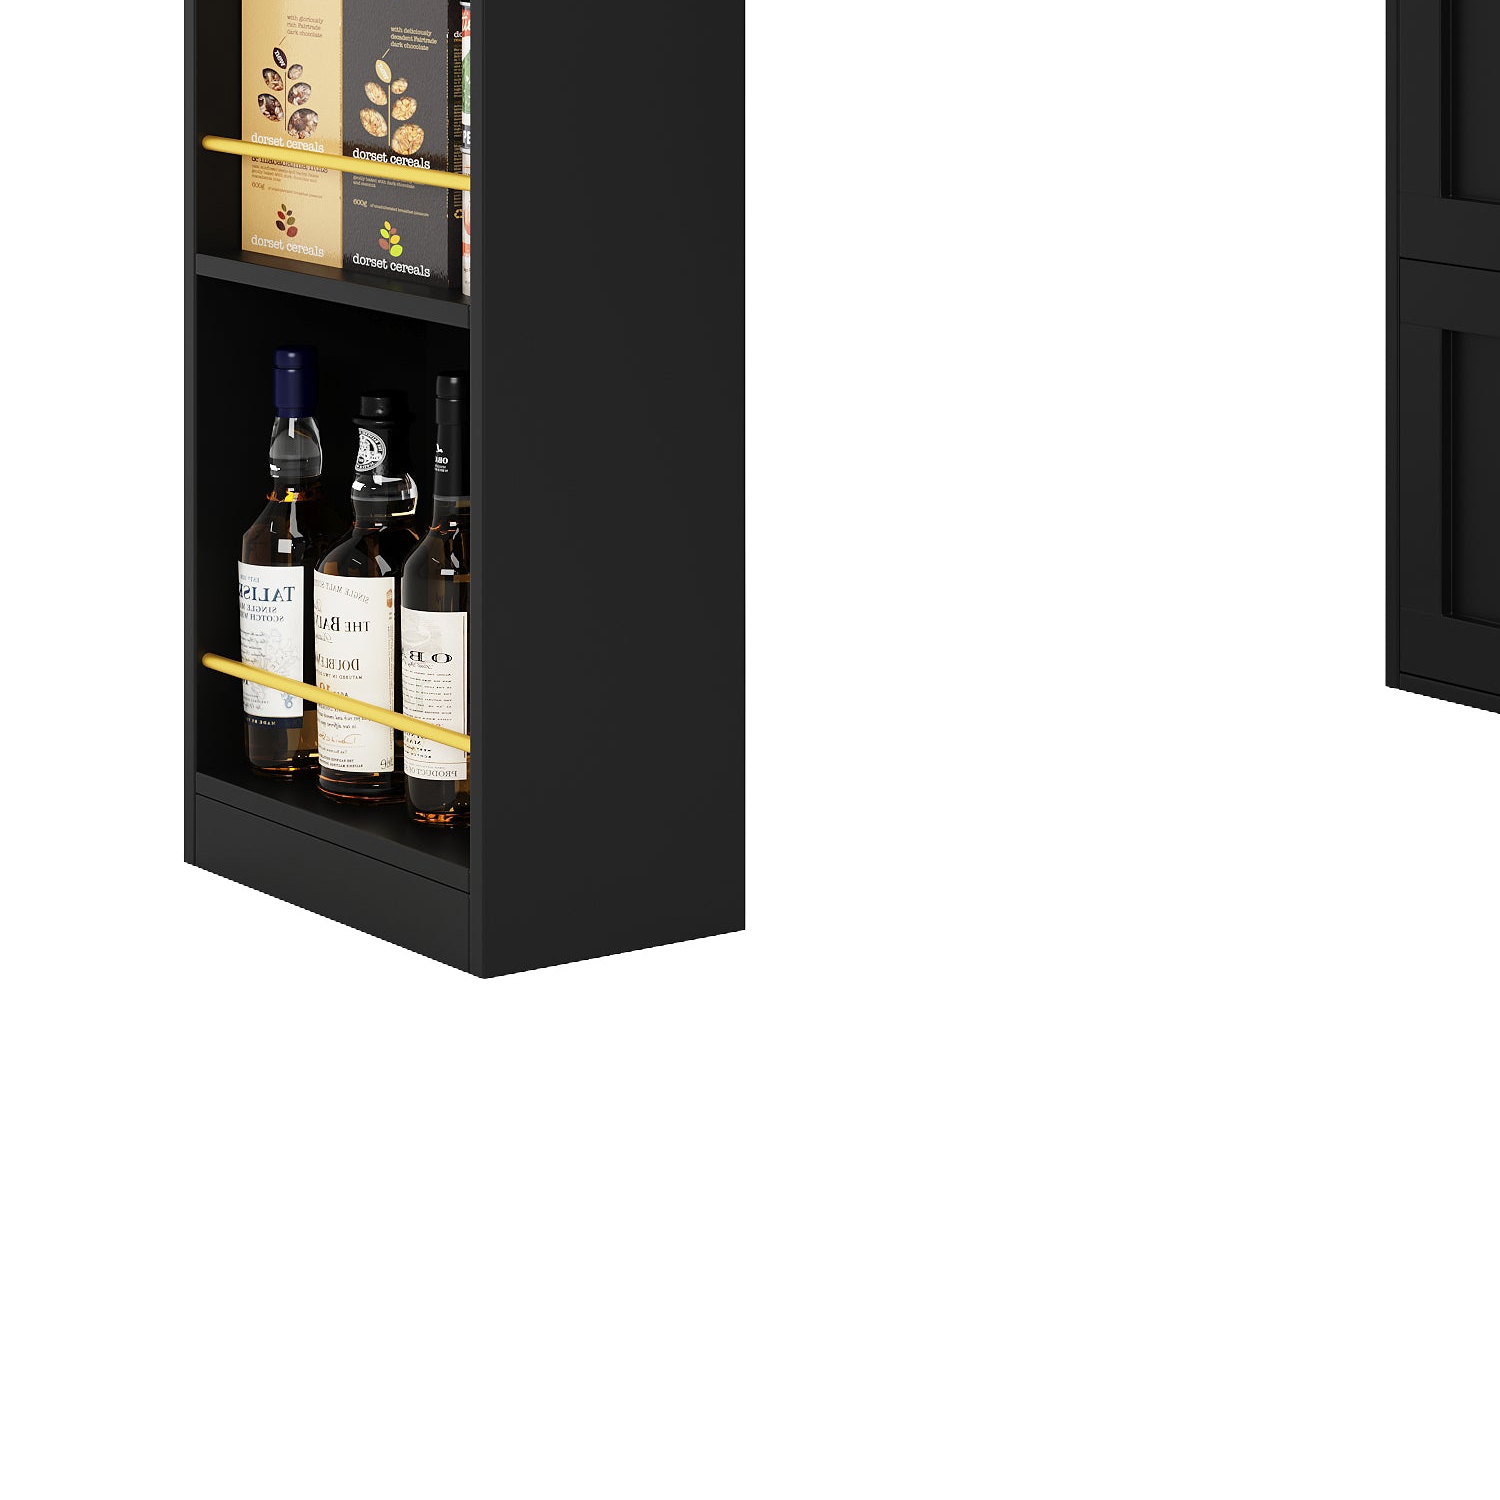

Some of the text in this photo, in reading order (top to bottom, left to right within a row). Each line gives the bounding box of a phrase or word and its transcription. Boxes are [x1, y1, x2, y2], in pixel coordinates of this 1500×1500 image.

[274, 49, 286, 67] new
[250, 132, 325, 153] dorset cereals
[352, 147, 431, 170] dorset cereals
[251, 234, 325, 258] dorset cereals
[352, 252, 431, 278] dorset cereals
